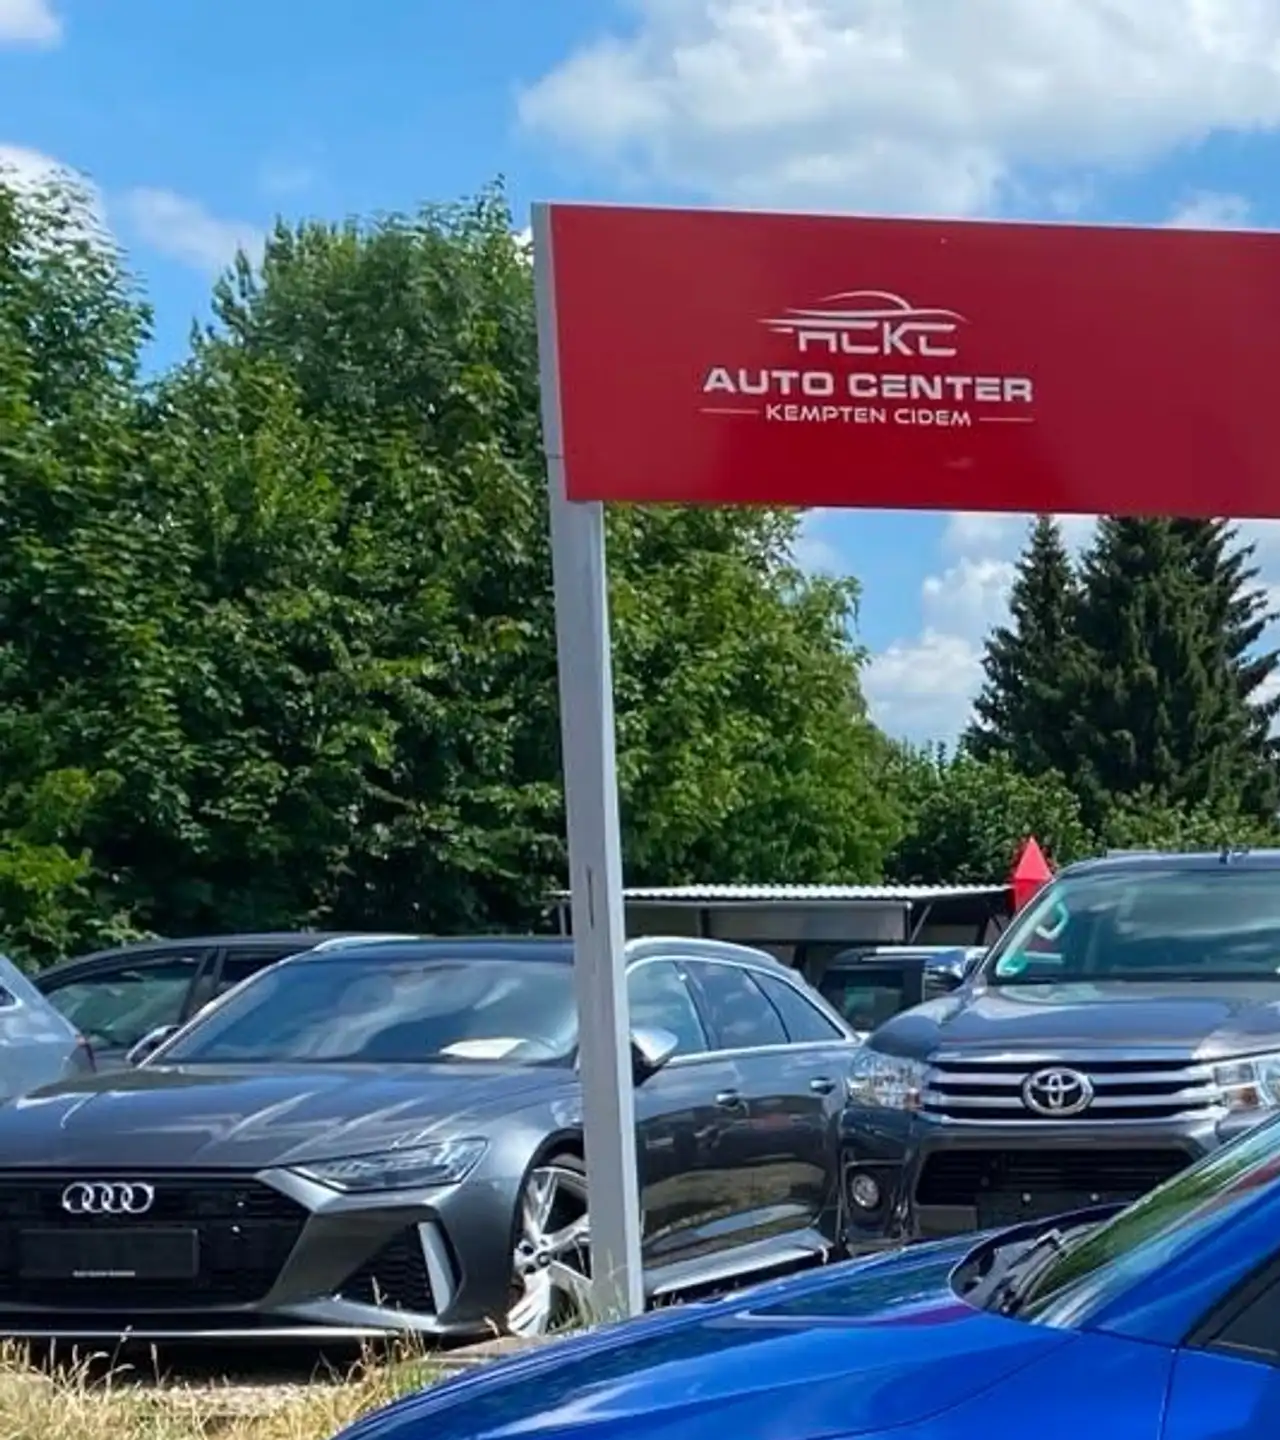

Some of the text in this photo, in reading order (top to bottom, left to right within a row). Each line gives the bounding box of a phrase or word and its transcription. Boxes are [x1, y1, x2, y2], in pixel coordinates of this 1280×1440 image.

[702, 367, 1033, 403] AUTO CENTER
[765, 403, 972, 427] KEMPTEN CIDEM
